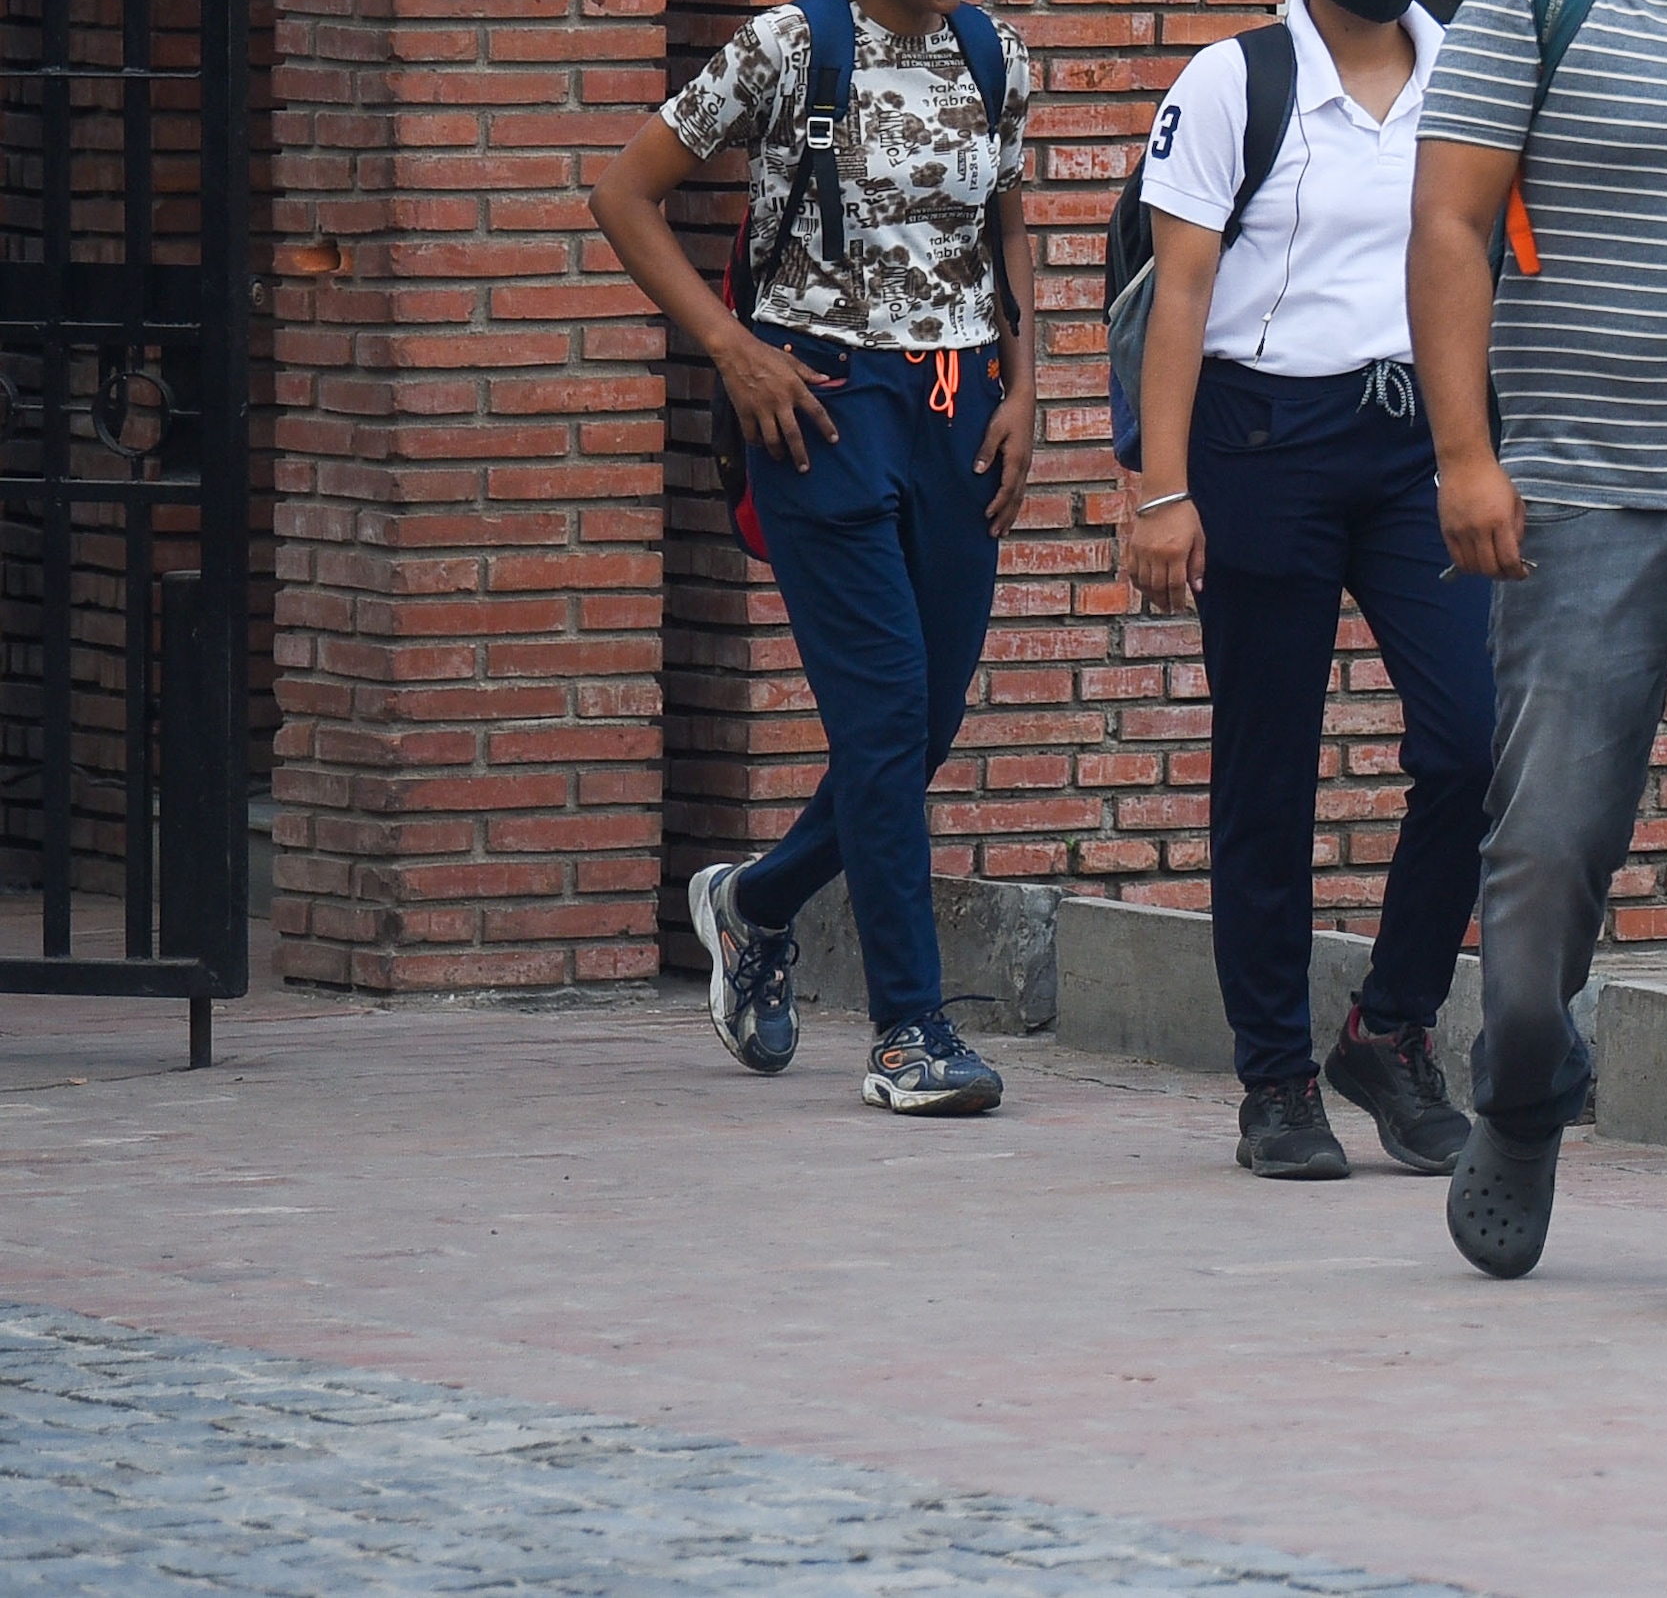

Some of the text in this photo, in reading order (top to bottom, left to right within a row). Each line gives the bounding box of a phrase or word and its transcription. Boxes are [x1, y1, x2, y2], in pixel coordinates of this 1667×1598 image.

[928, 81, 976, 95] taking
[1151, 105, 1182, 160] 3
[929, 233, 972, 245] taking
